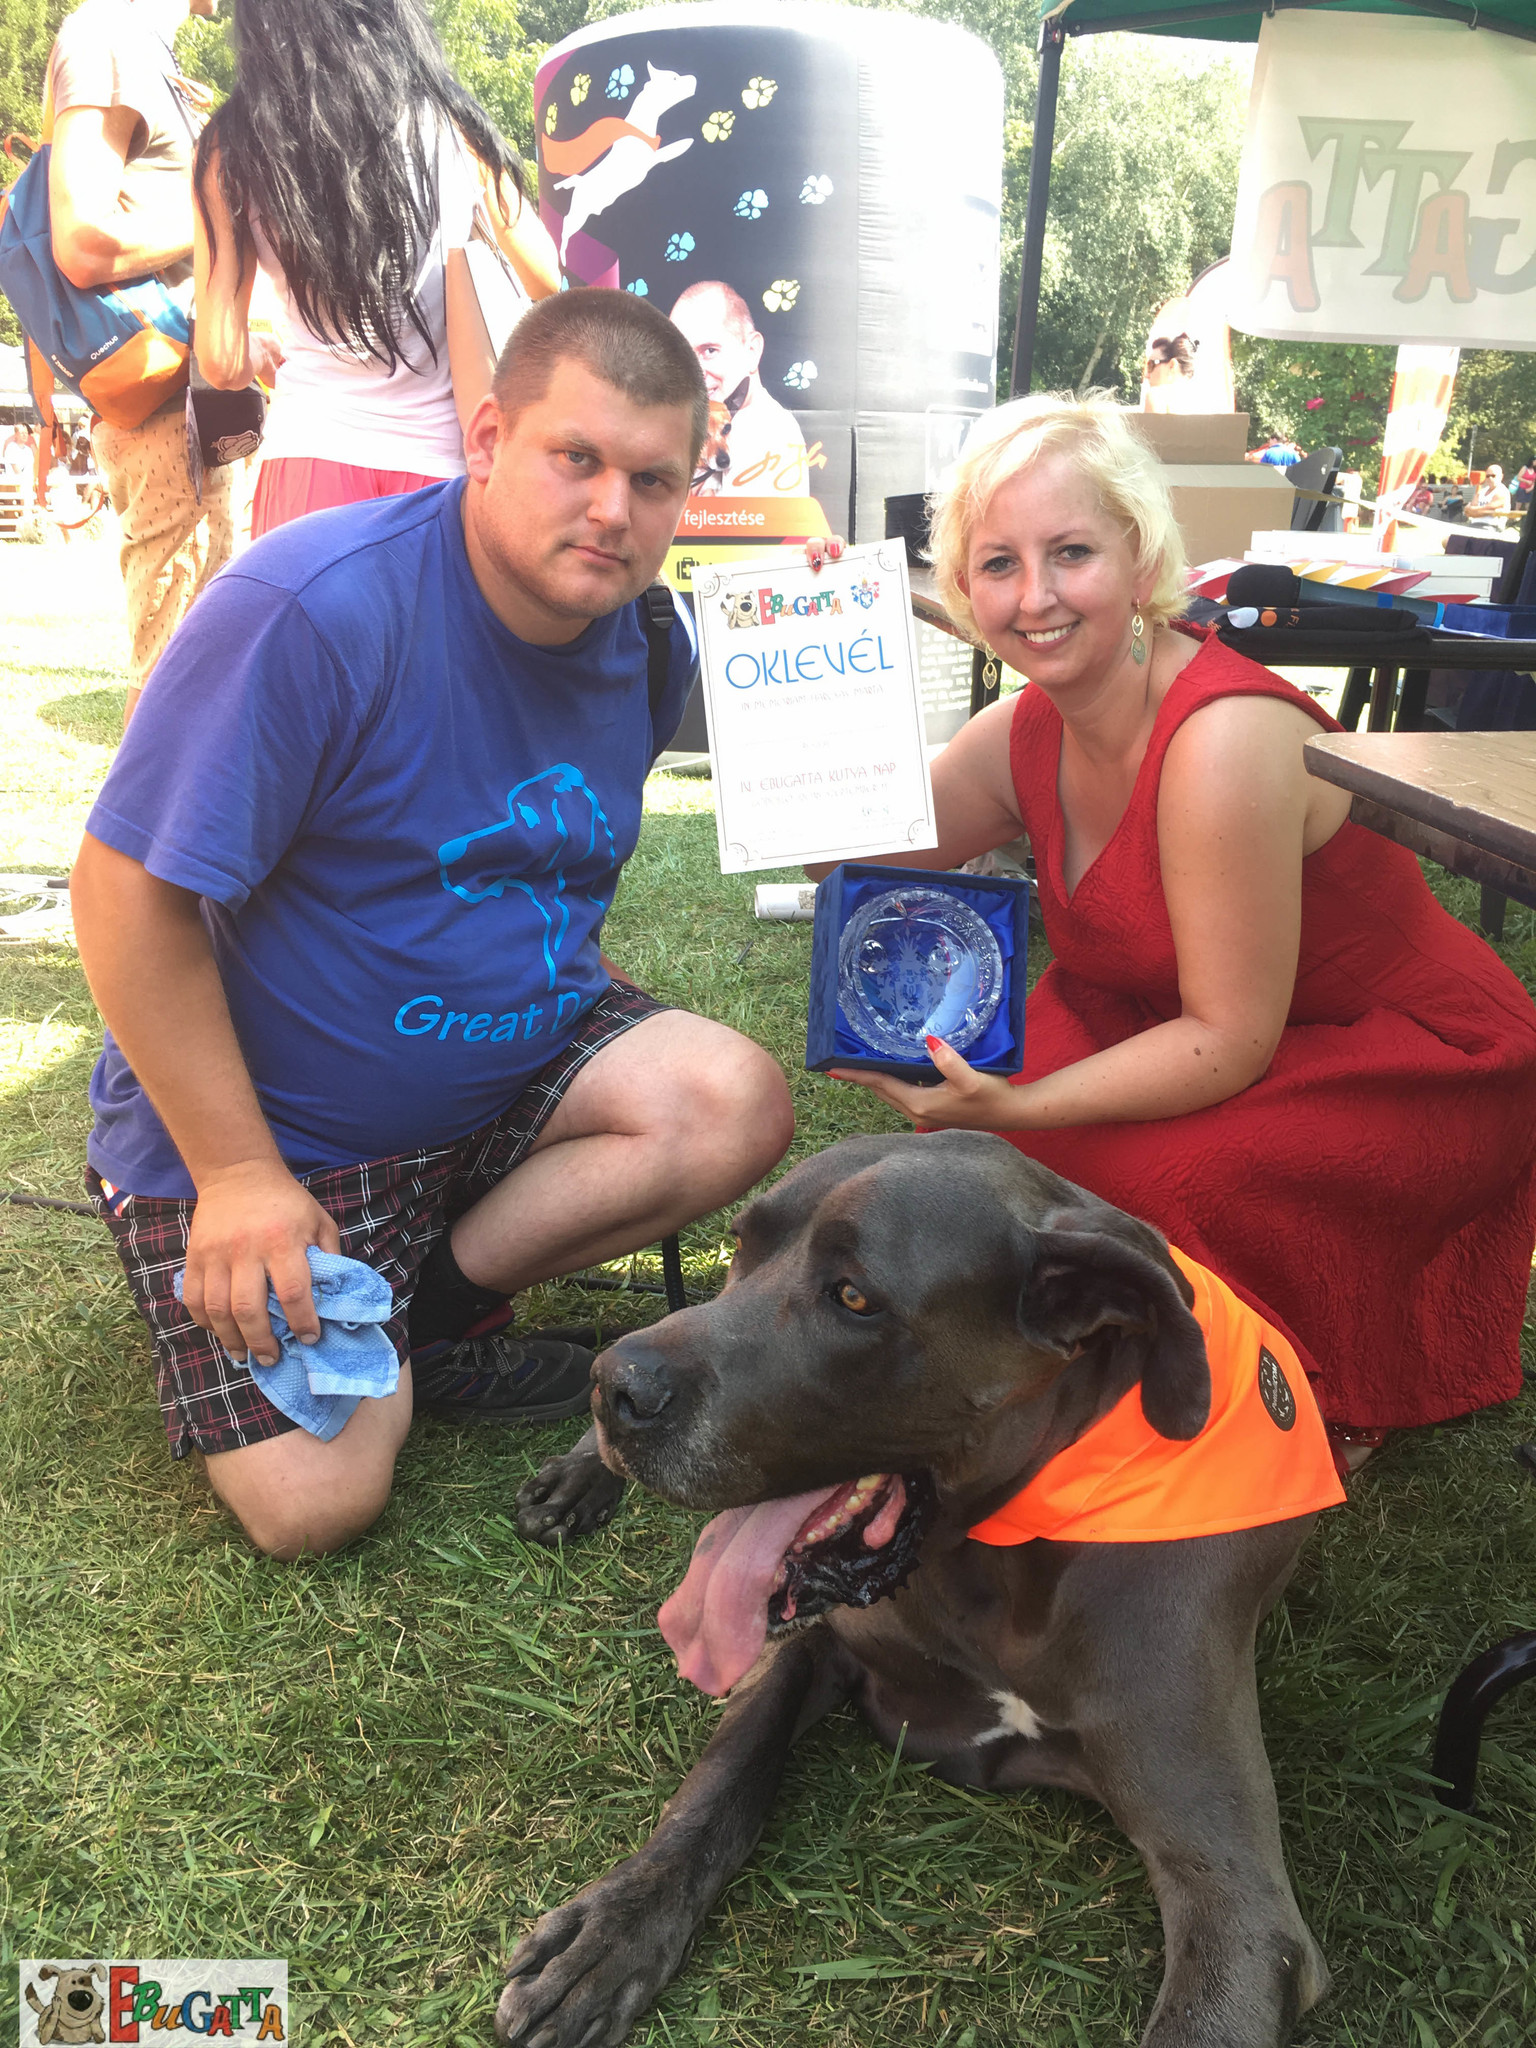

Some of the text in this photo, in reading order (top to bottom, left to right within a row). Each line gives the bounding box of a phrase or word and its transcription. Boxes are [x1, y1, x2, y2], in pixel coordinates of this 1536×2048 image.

[684, 509, 766, 529] fejlesztése
[725, 629, 894, 689] OKLEVÉL
[760, 772, 823, 791] EBUGATTA
[828, 766, 868, 782] KUTYA
[873, 762, 896, 777] NAP
[394, 994, 543, 1042] Great
